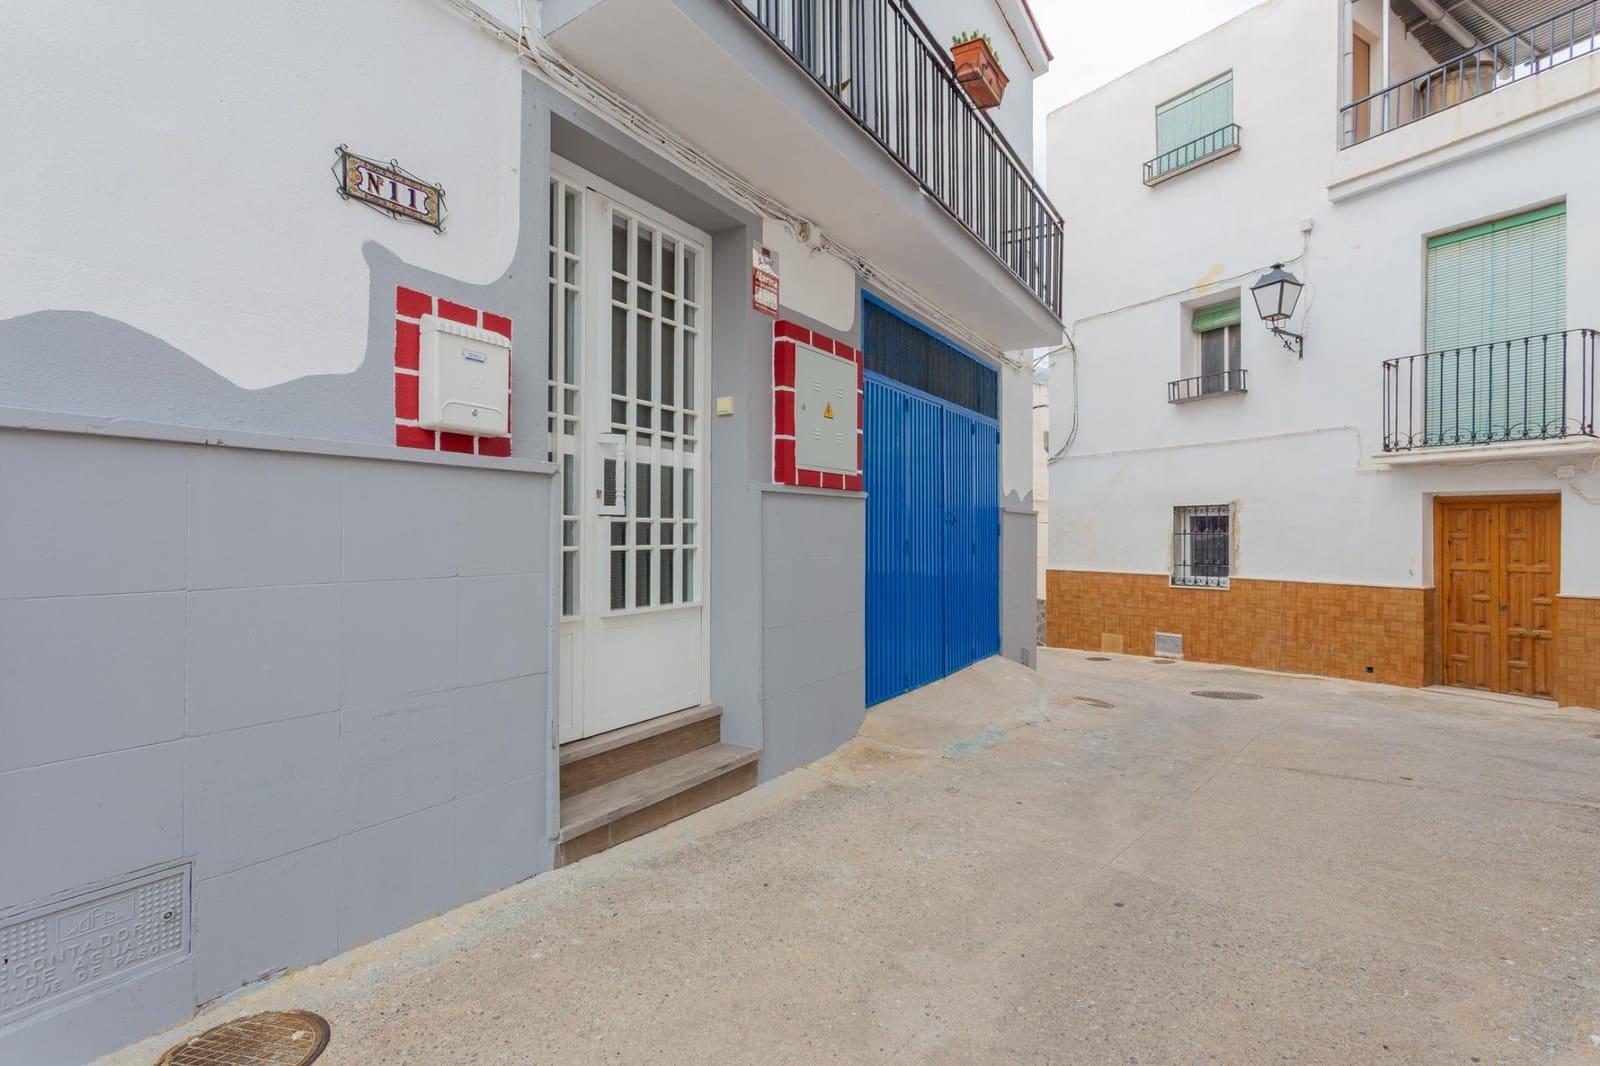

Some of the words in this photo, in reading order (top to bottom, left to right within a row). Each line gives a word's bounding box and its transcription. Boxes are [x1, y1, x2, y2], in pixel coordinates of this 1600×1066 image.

[13, 923, 145, 980] CONTADOR
[23, 965, 57, 991] DE
[71, 940, 136, 973] AGUA
[114, 944, 160, 969] PASO
